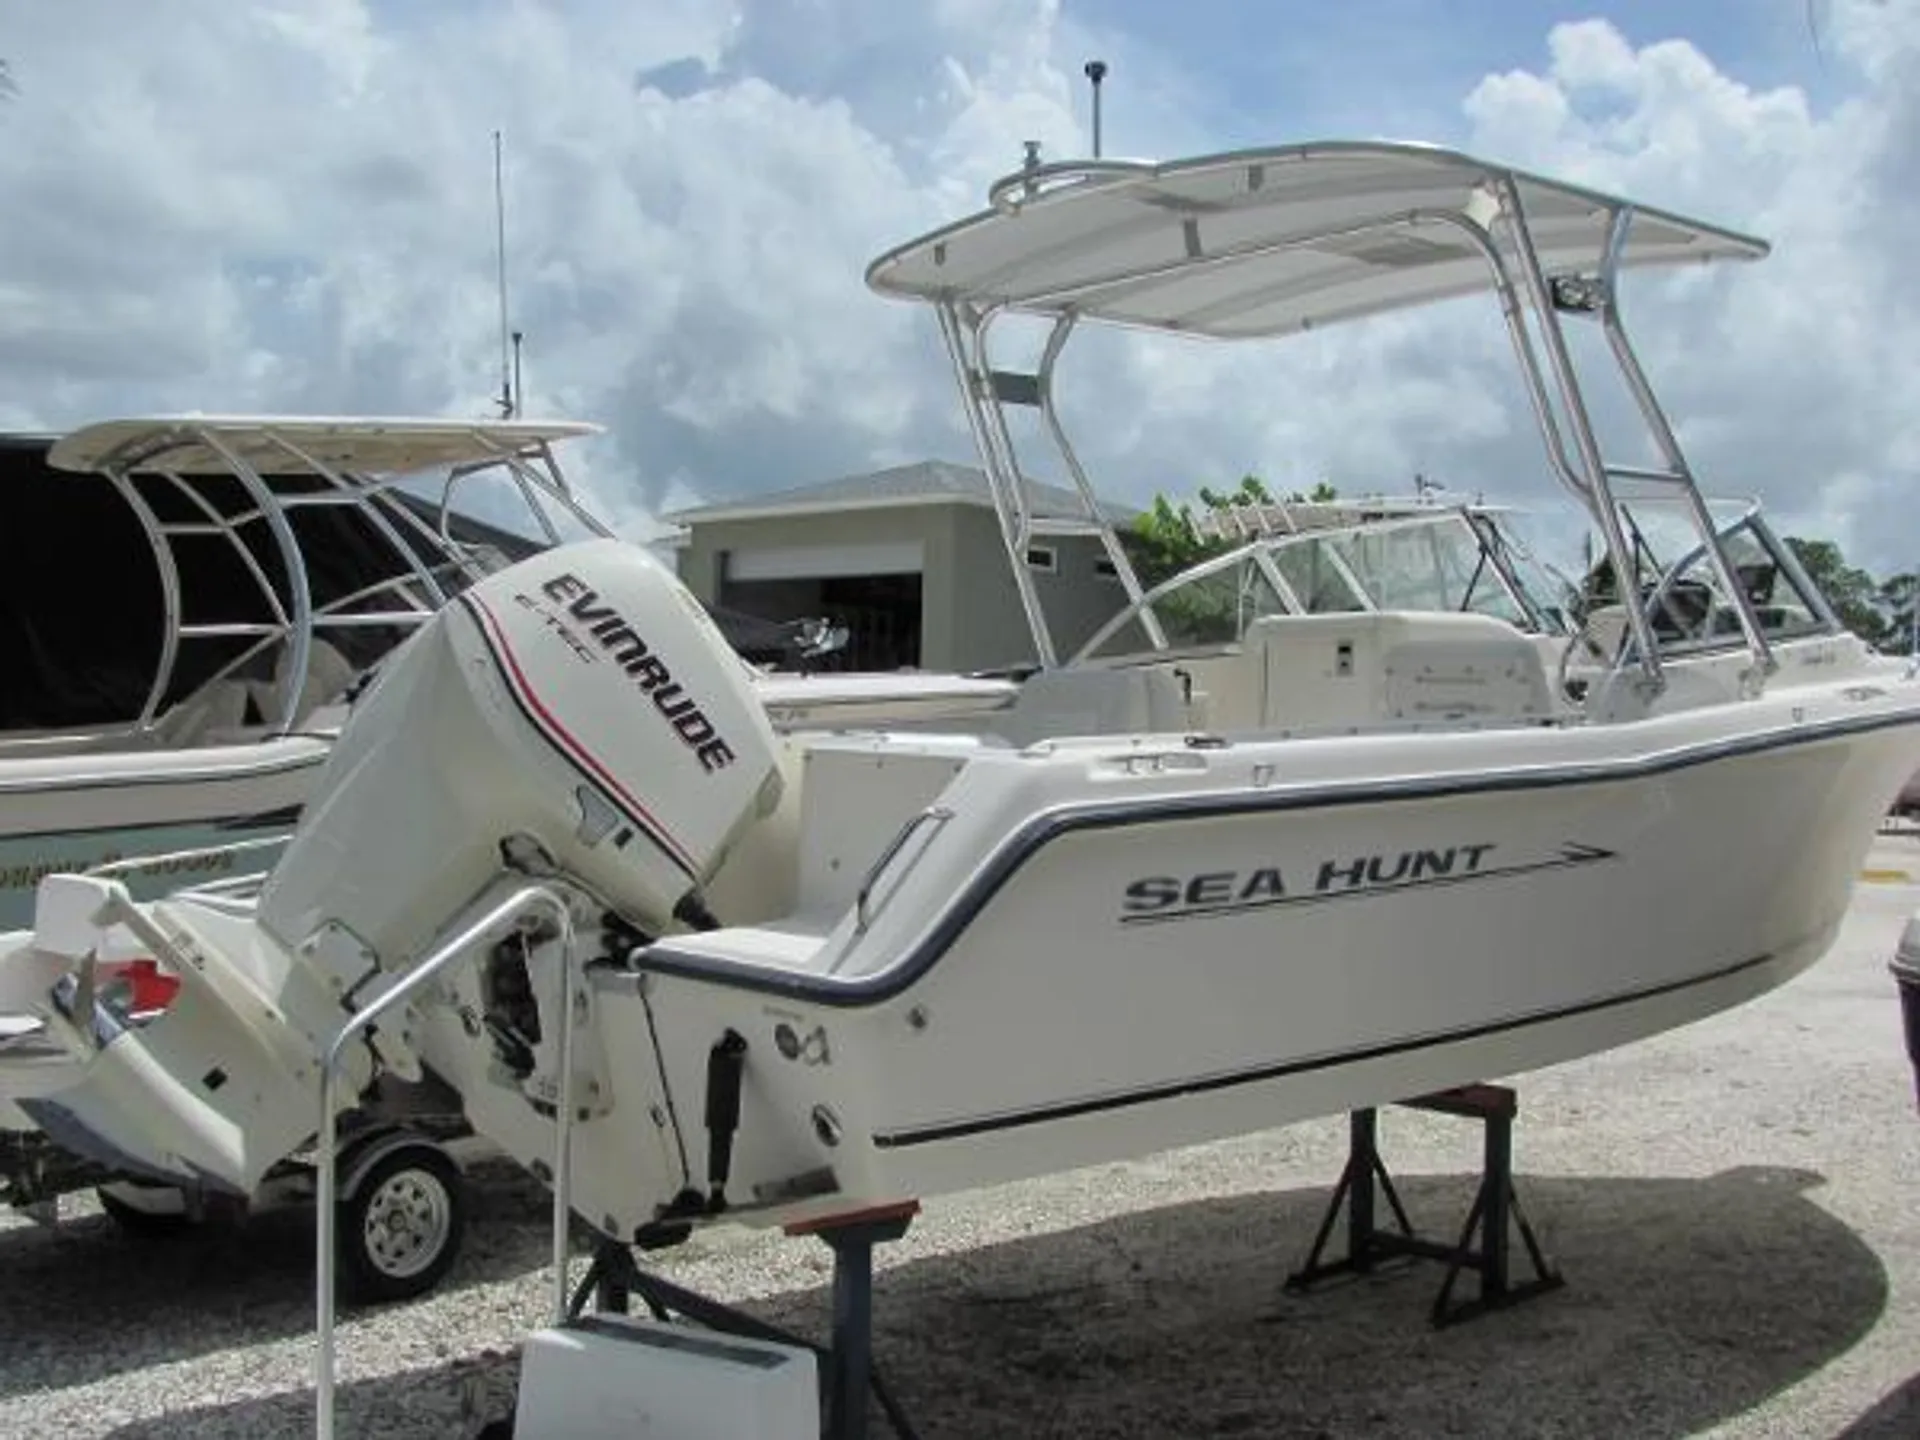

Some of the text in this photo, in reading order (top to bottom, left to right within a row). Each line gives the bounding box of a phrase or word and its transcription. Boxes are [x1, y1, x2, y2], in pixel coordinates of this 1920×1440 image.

[543, 573, 735, 774] EVINRUDE
[1122, 843, 1499, 911] SEA HUNT
